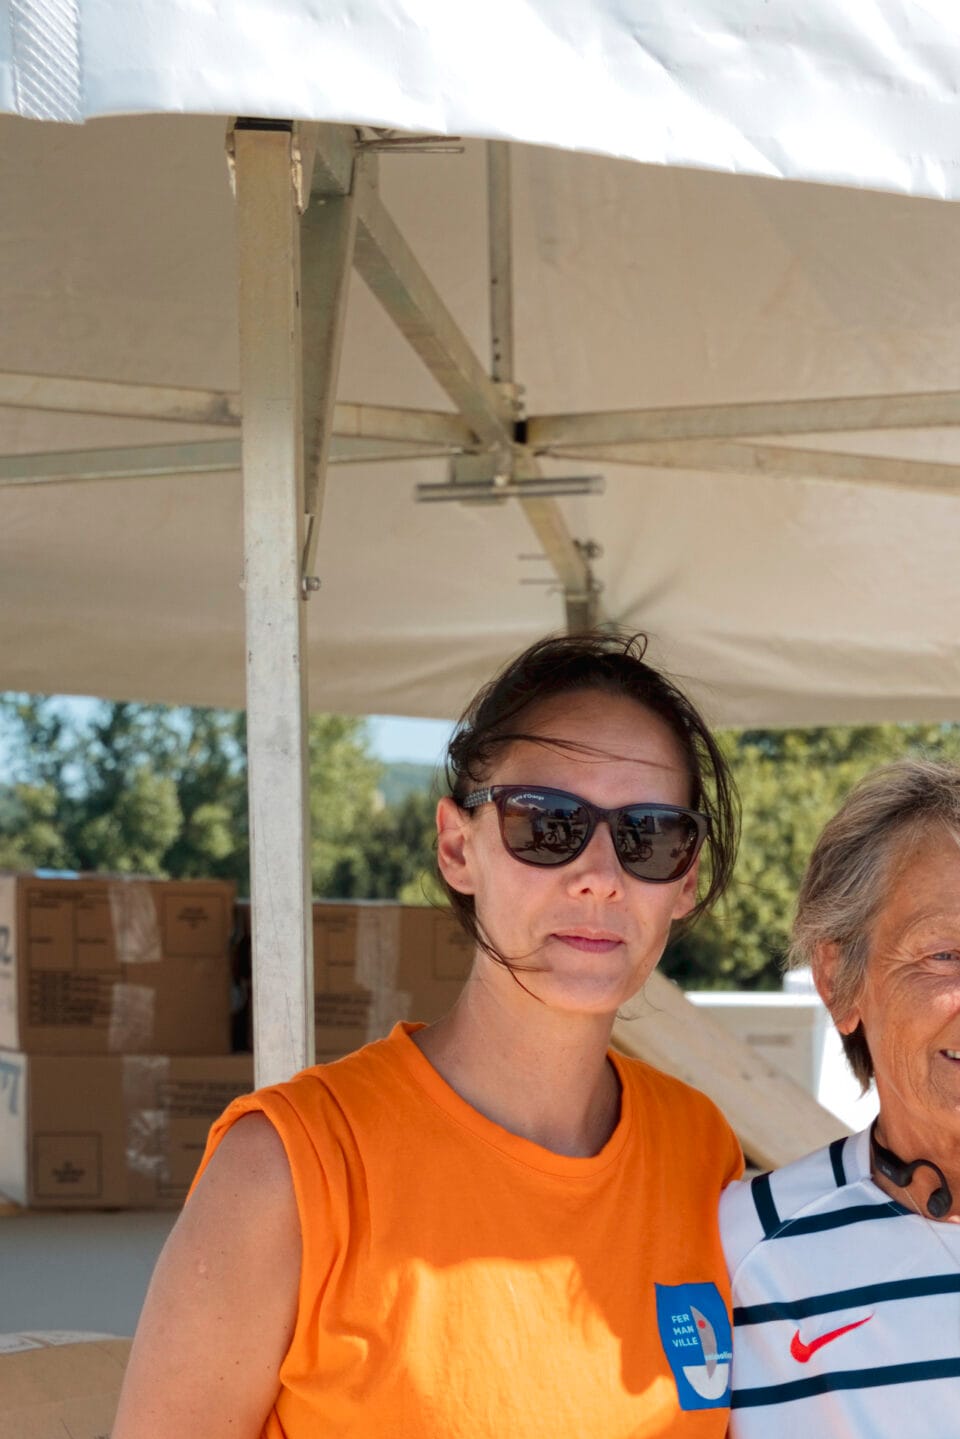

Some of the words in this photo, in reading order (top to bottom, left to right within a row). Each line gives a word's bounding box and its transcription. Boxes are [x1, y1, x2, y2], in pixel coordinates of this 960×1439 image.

[672, 1313, 689, 1323] FER
[673, 1325, 694, 1335] MAN
[672, 1336, 698, 1347] VILLE
